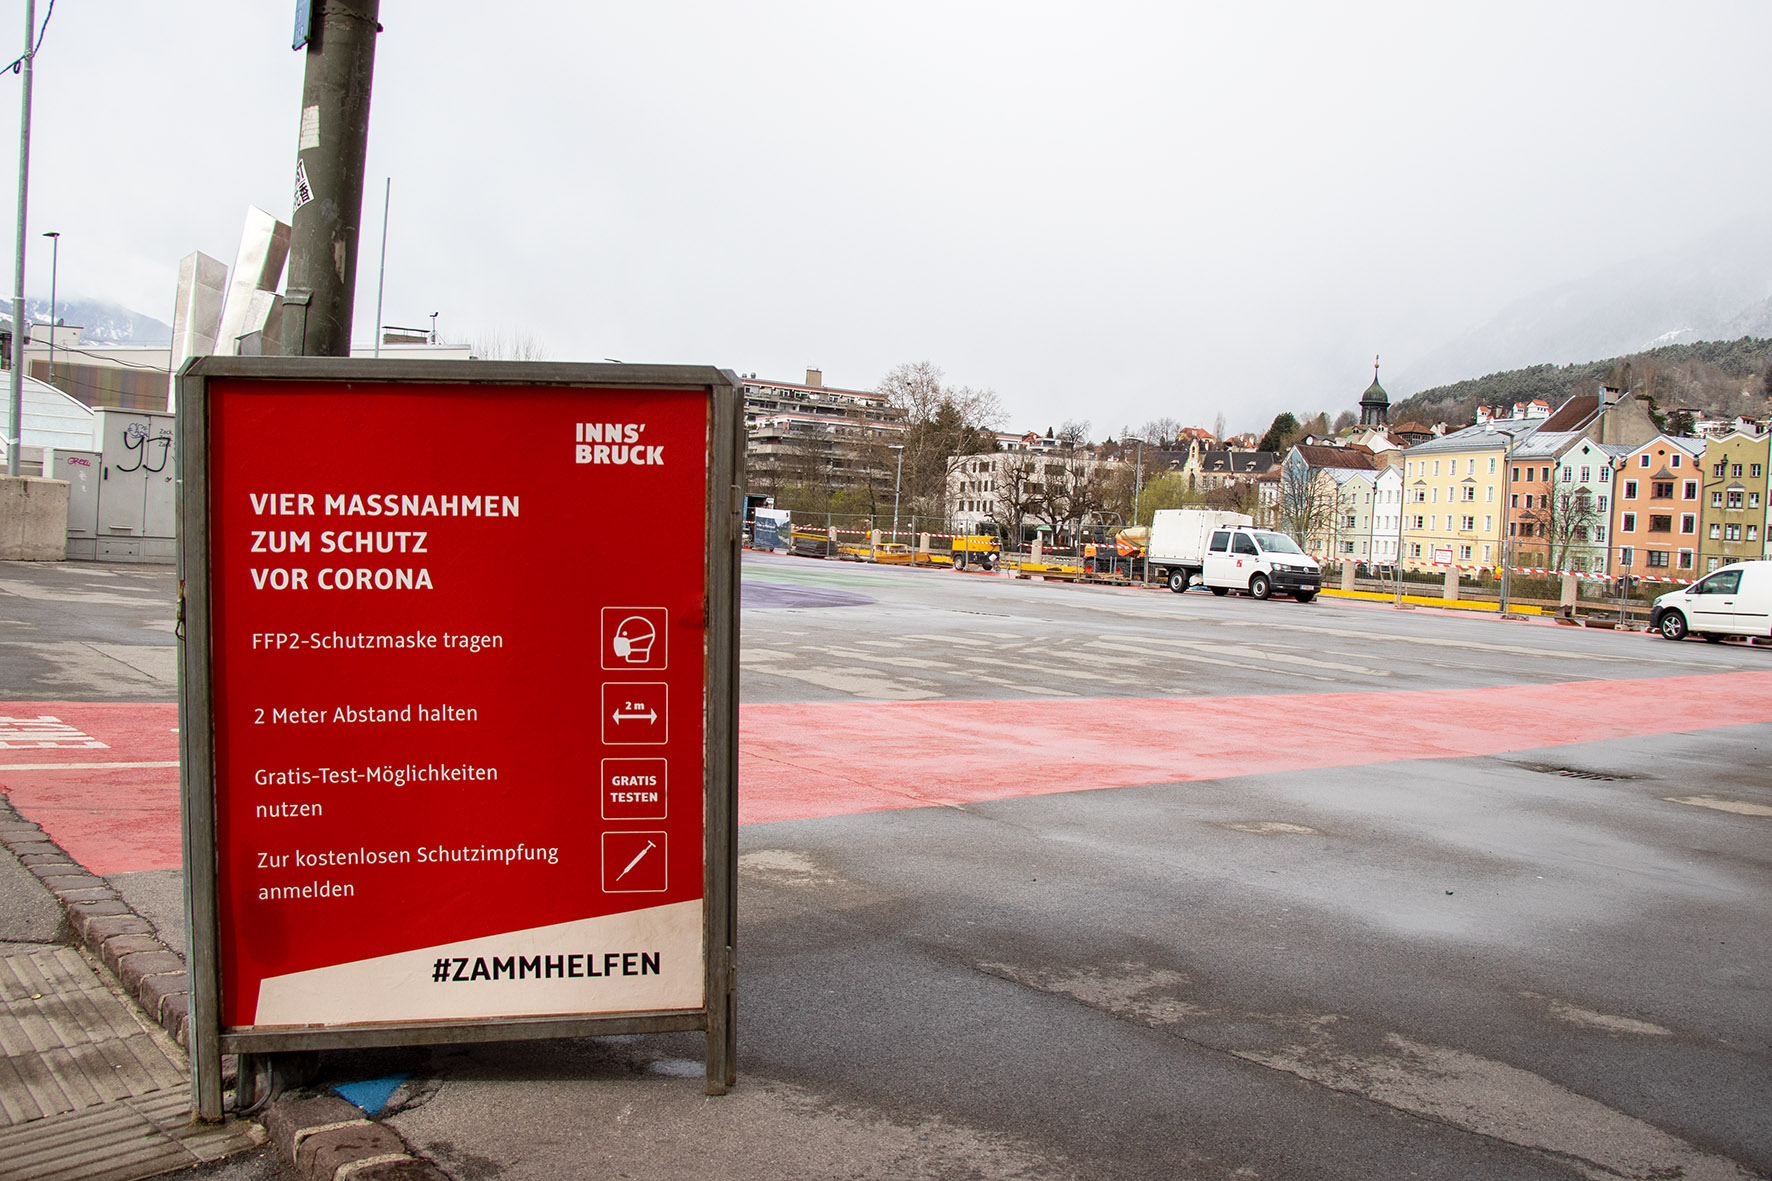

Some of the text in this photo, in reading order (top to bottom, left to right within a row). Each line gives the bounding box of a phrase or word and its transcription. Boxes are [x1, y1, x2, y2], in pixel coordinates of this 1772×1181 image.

[575, 444, 664, 466] BRUCK
[249, 492, 520, 518] VIER MASSNAHMEN
[250, 530, 428, 554] ZUM SCHUTZ
[249, 567, 434, 591] VOR CORONA
[252, 630, 504, 653] FFP2-Schutzmaske tragen
[254, 703, 478, 725] 2 Meter Abstand halten
[625, 700, 645, 711] 2 m
[254, 763, 498, 787] Gratis-Test-Möglichkeiten
[611, 775, 657, 787] GRATIS
[610, 791, 659, 803] TESTEN
[256, 801, 323, 818] nutzen
[257, 842, 559, 869] Zur kostenlosen Schutzimpfung
[258, 879, 355, 901] anmelden
[432, 951, 661, 983] #ZAMMHELFEN
